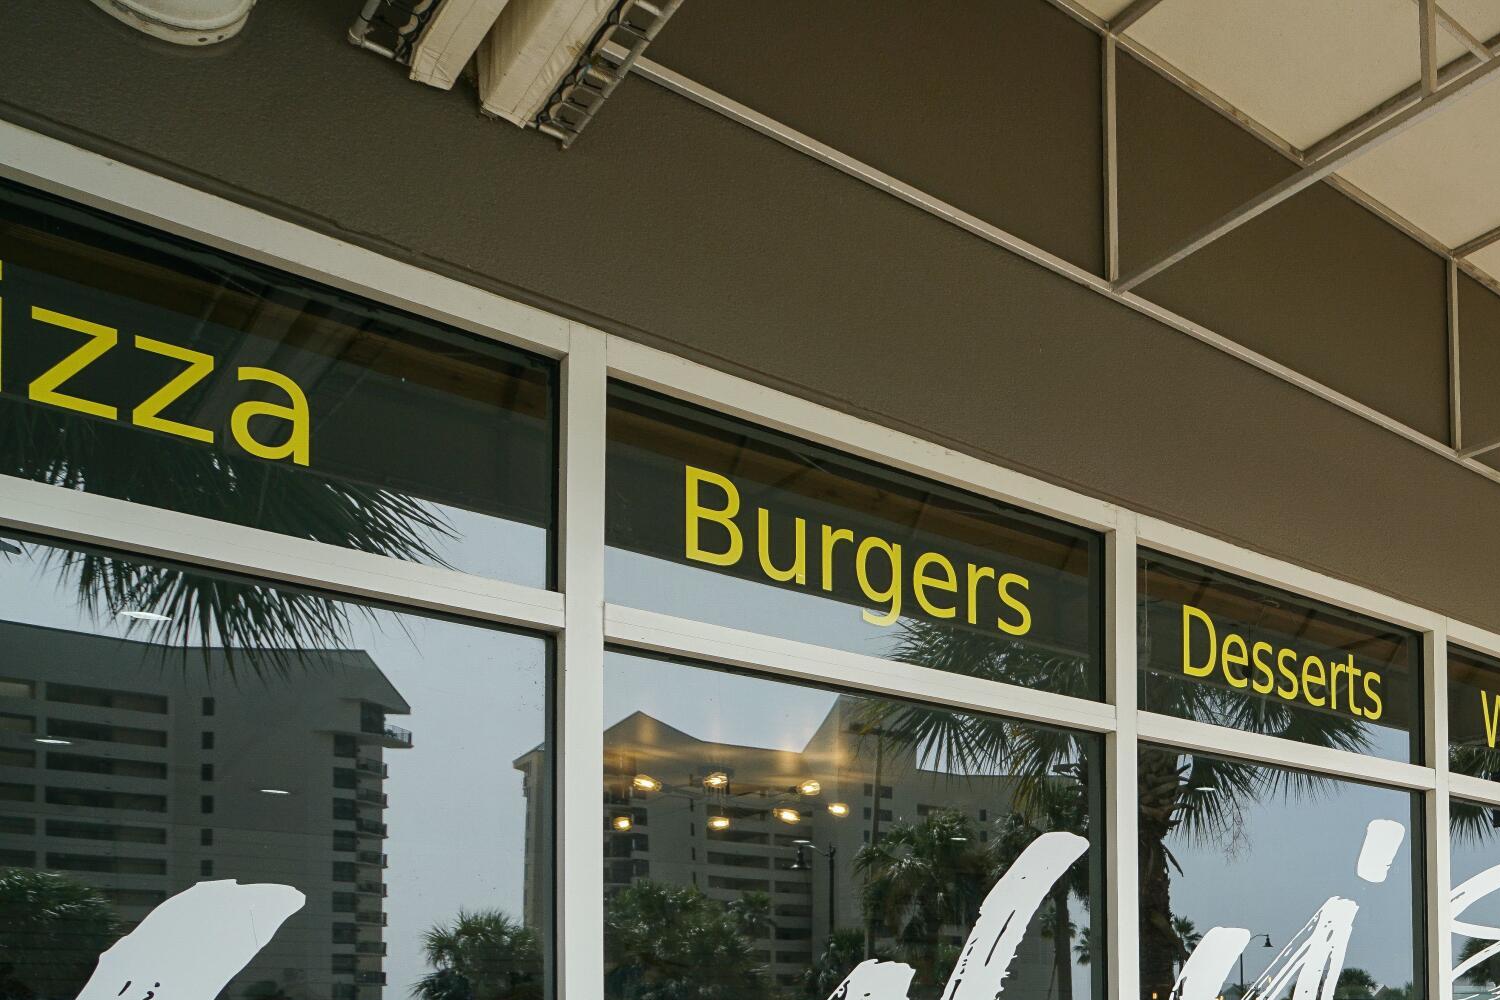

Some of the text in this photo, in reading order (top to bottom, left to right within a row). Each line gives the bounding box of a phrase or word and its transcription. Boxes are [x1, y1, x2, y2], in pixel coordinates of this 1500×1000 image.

[0, 260, 310, 467] zza
[685, 465, 1031, 636] Burgers
[1183, 605, 1382, 720] Desserts
